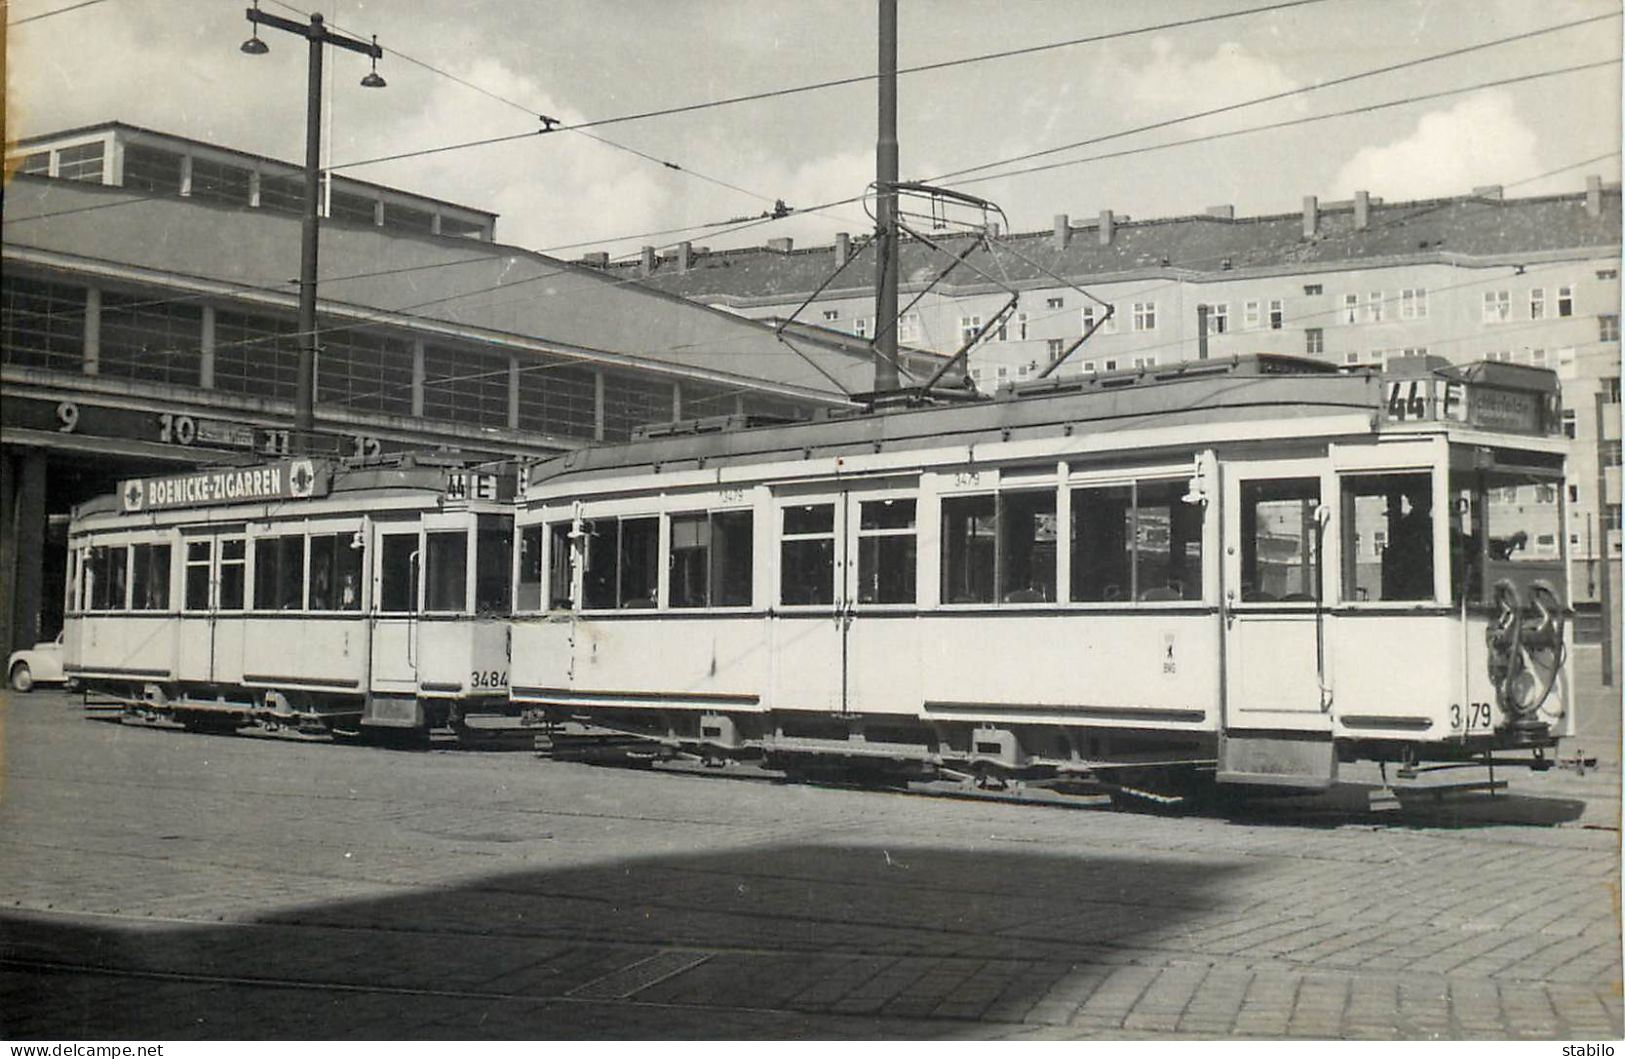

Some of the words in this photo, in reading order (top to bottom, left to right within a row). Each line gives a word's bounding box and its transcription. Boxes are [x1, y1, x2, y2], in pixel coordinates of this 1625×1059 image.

[1388, 382, 1424, 421] 44
[56, 402, 79, 433] 9
[160, 413, 195, 445] 10
[264, 430, 289, 455] 11
[353, 435, 382, 459] 12
[150, 469, 281, 505] BOENICKE-ZIGARREN
[447, 474, 465, 498] 44
[477, 474, 490, 498] E
[471, 671, 509, 688] 3484
